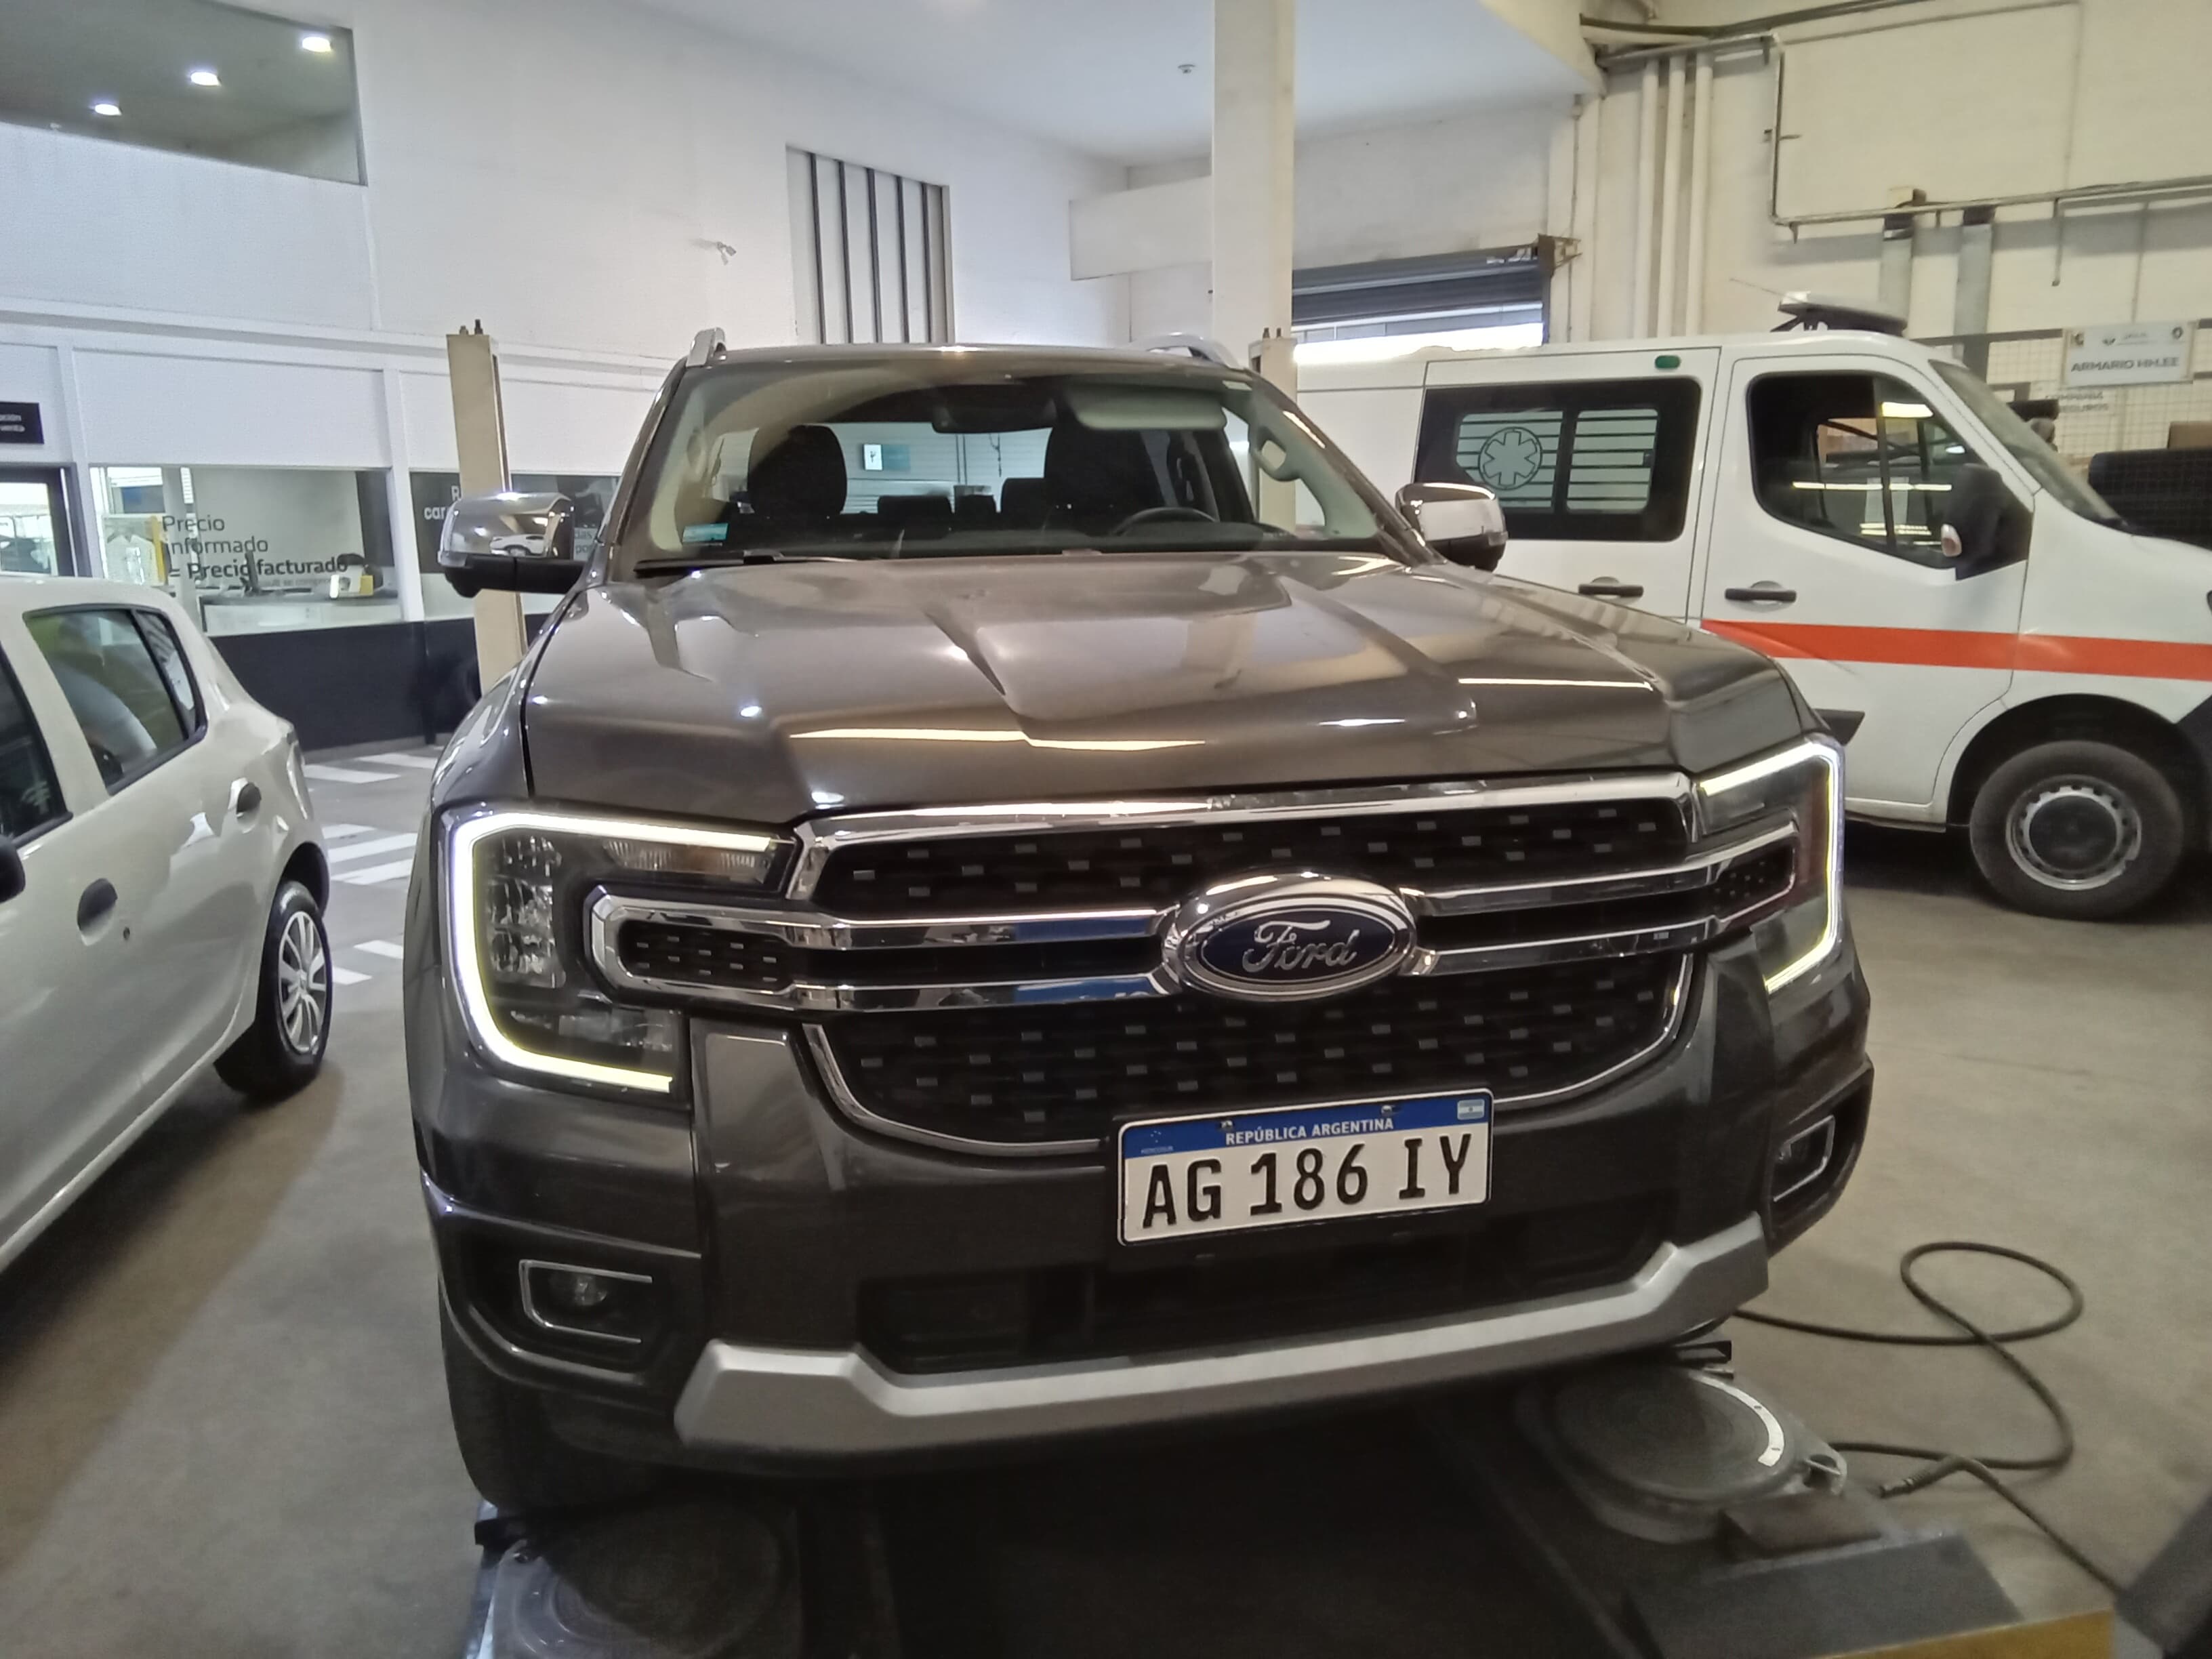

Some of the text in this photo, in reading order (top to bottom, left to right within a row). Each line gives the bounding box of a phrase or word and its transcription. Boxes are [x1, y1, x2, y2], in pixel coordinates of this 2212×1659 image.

[2071, 360, 2134, 372] ARMARIO
[424, 506, 446, 520] car
[162, 515, 225, 532] Precio
[256, 556, 348, 575] facturado
[1242, 919, 1360, 972] Ford
[1225, 1118, 1393, 1145] REPÚBLICA ARGENTINA
[1142, 1132, 1472, 1229] AG 186 IY
